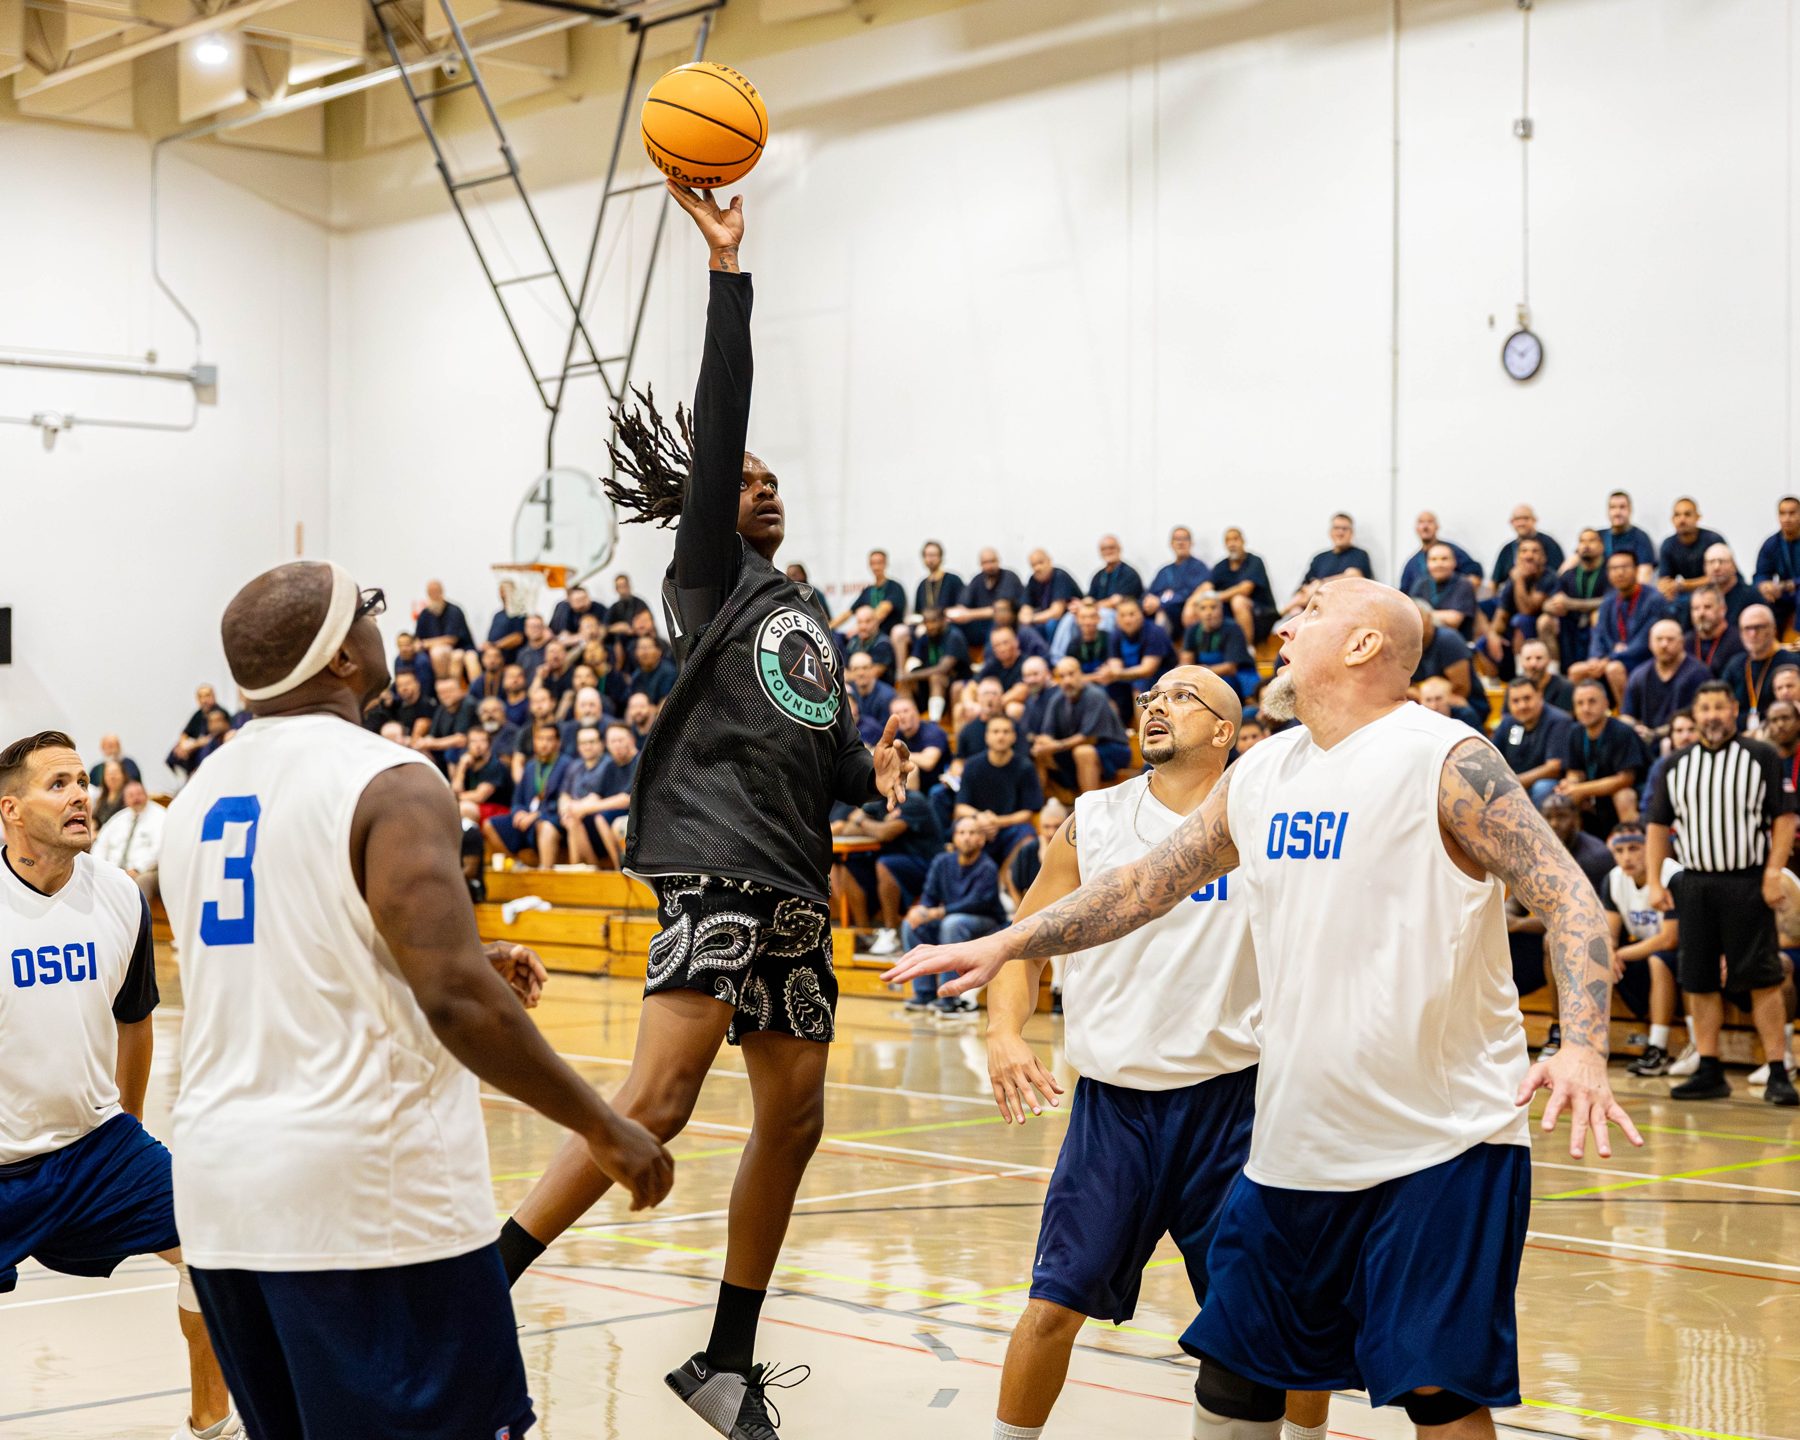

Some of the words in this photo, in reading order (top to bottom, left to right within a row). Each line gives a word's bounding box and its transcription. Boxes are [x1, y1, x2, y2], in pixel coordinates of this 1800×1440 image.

[646, 142, 722, 184] Wilson
[770, 614, 802, 638] SIDE
[1266, 811, 1349, 860] OSCI
[200, 794, 261, 946] 3
[11, 942, 97, 988] OSCI
